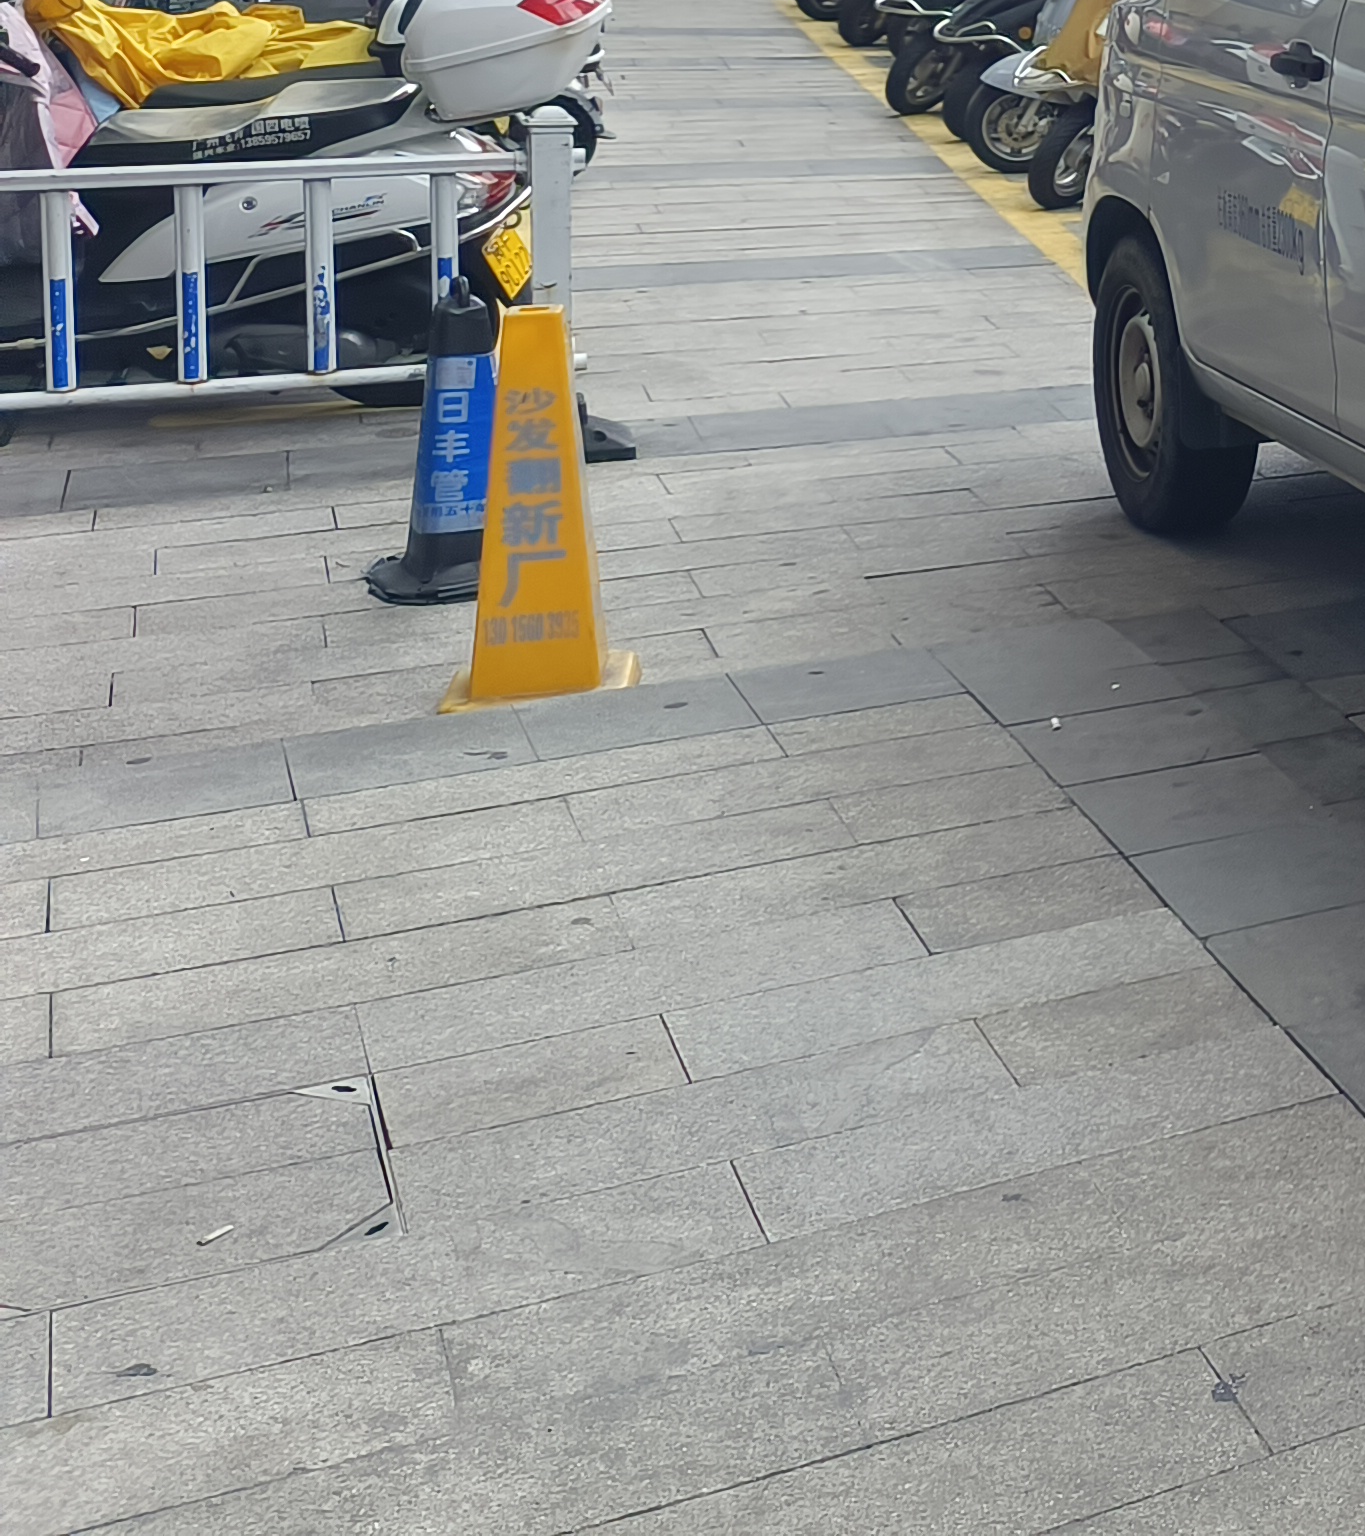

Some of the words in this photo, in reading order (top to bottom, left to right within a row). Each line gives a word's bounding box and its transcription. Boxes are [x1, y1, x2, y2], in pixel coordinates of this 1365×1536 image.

[431, 391, 470, 502] 日丰管
[498, 387, 567, 609] 沙发翻新厂
